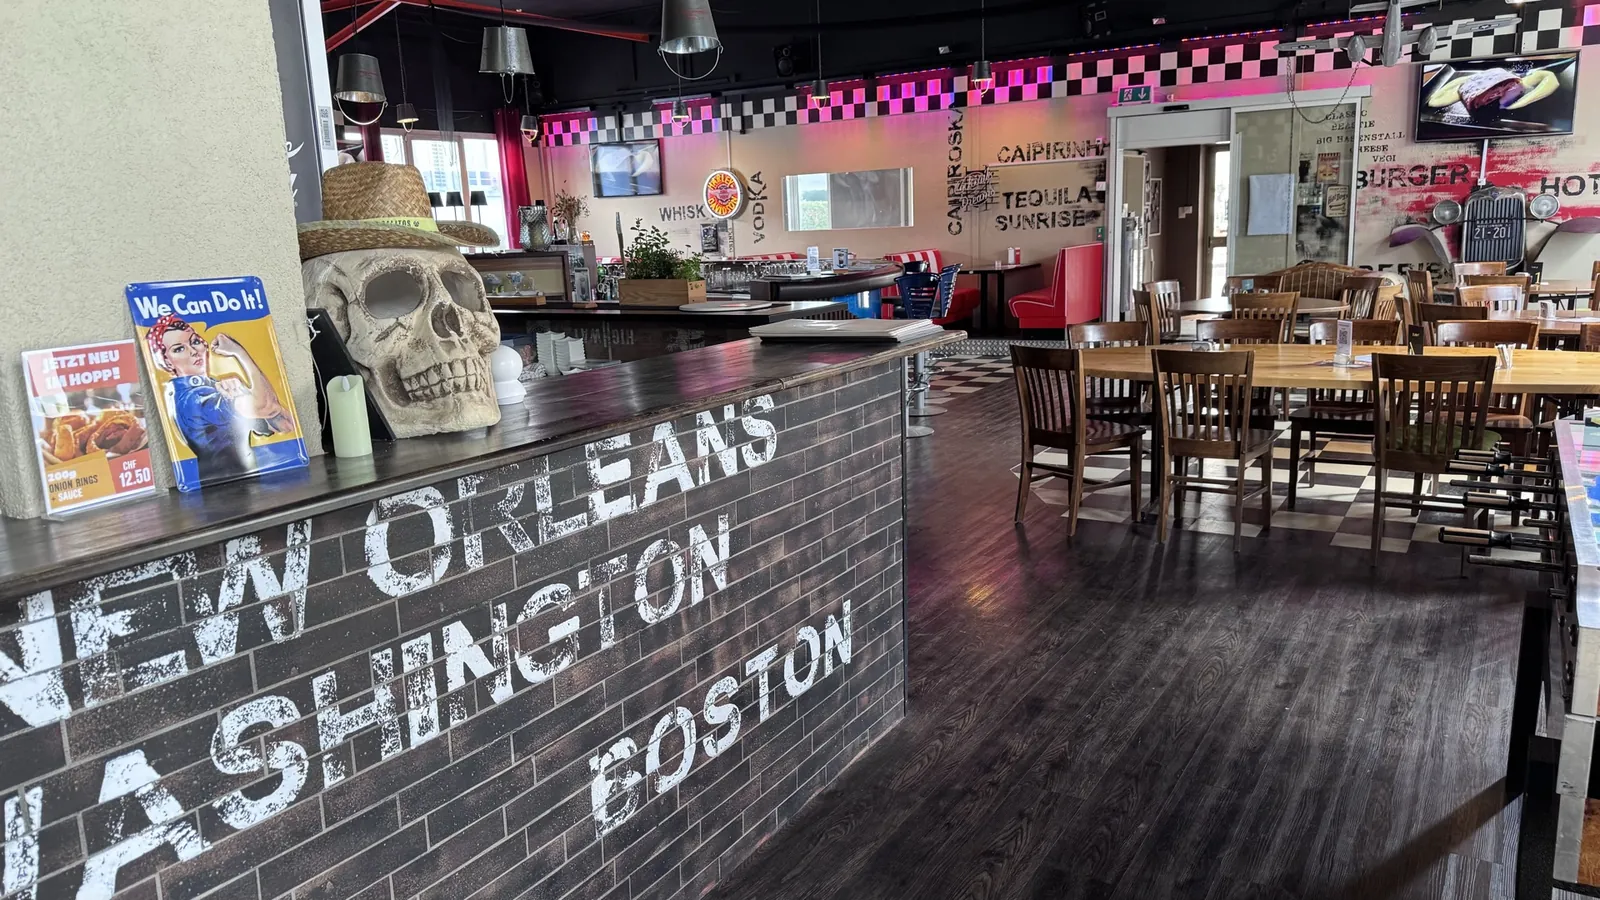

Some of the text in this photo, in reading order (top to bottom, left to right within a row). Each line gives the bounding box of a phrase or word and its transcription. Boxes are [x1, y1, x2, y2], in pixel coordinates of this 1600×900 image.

[1325, 110, 1368, 120] CLASSC
[1316, 136, 1332, 144] BIG
[1356, 163, 1470, 189] BURGER
[1540, 173, 1600, 197] HOT
[708, 195, 738, 216] DAVIDSON
[747, 171, 768, 244] VODKA
[1002, 186, 1092, 209] TEQUILA
[659, 204, 715, 221] WHISK
[995, 210, 1086, 231] SUNRISE
[1474, 227, 1511, 239] 21-201
[134, 288, 264, 320] We Can Do It!
[42, 350, 120, 374] JETZT NEU
[46, 367, 121, 390] IM HOPP!
[123, 459, 137, 470] CHF
[47, 470, 77, 482] 200g
[49, 475, 99, 493] ONION RINGS
[119, 467, 151, 488] 12.50
[58, 489, 83, 502] SAUCE
[0, 394, 777, 728] NEW ORLEANS
[2, 512, 730, 900] ASHINGTON
[590, 599, 852, 840] BOSTON
